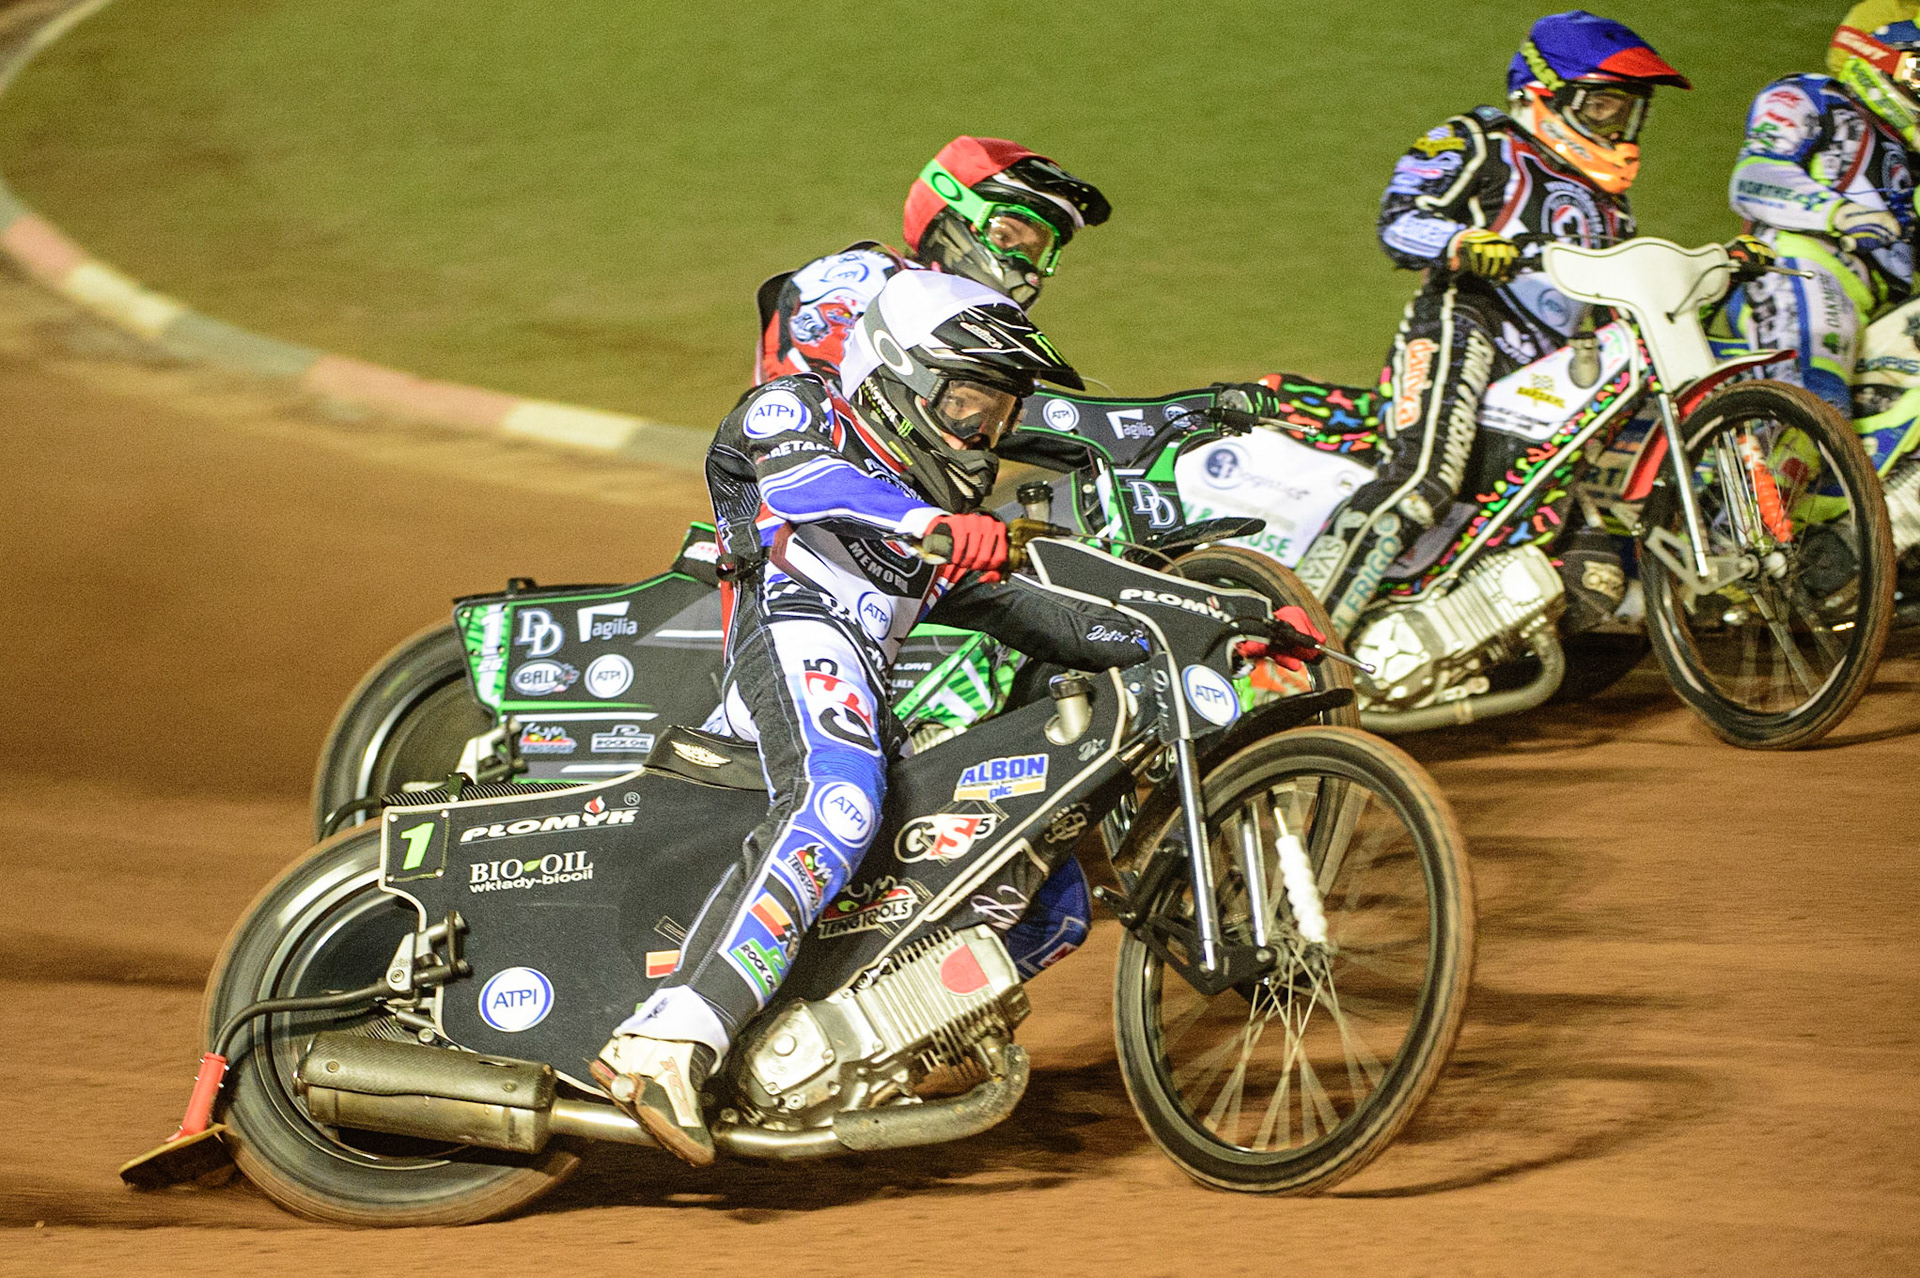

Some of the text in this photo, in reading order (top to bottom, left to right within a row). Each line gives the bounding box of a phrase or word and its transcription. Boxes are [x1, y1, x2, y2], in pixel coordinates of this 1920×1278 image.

[753, 404, 795, 421] ATPI
[1122, 421, 1156, 439] agilia
[1345, 536, 1399, 612] FRIGO
[592, 616, 638, 640] agilia
[595, 669, 622, 682] ATPI
[1194, 684, 1230, 706] ATPI
[960, 756, 1045, 785] ALBON
[989, 785, 1013, 800] plc
[829, 795, 868, 831] ATPI
[400, 822, 435, 870] 1
[469, 850, 594, 884] BIO OIL
[741, 944, 769, 974] ROCK
[493, 988, 538, 1010] ATPI
